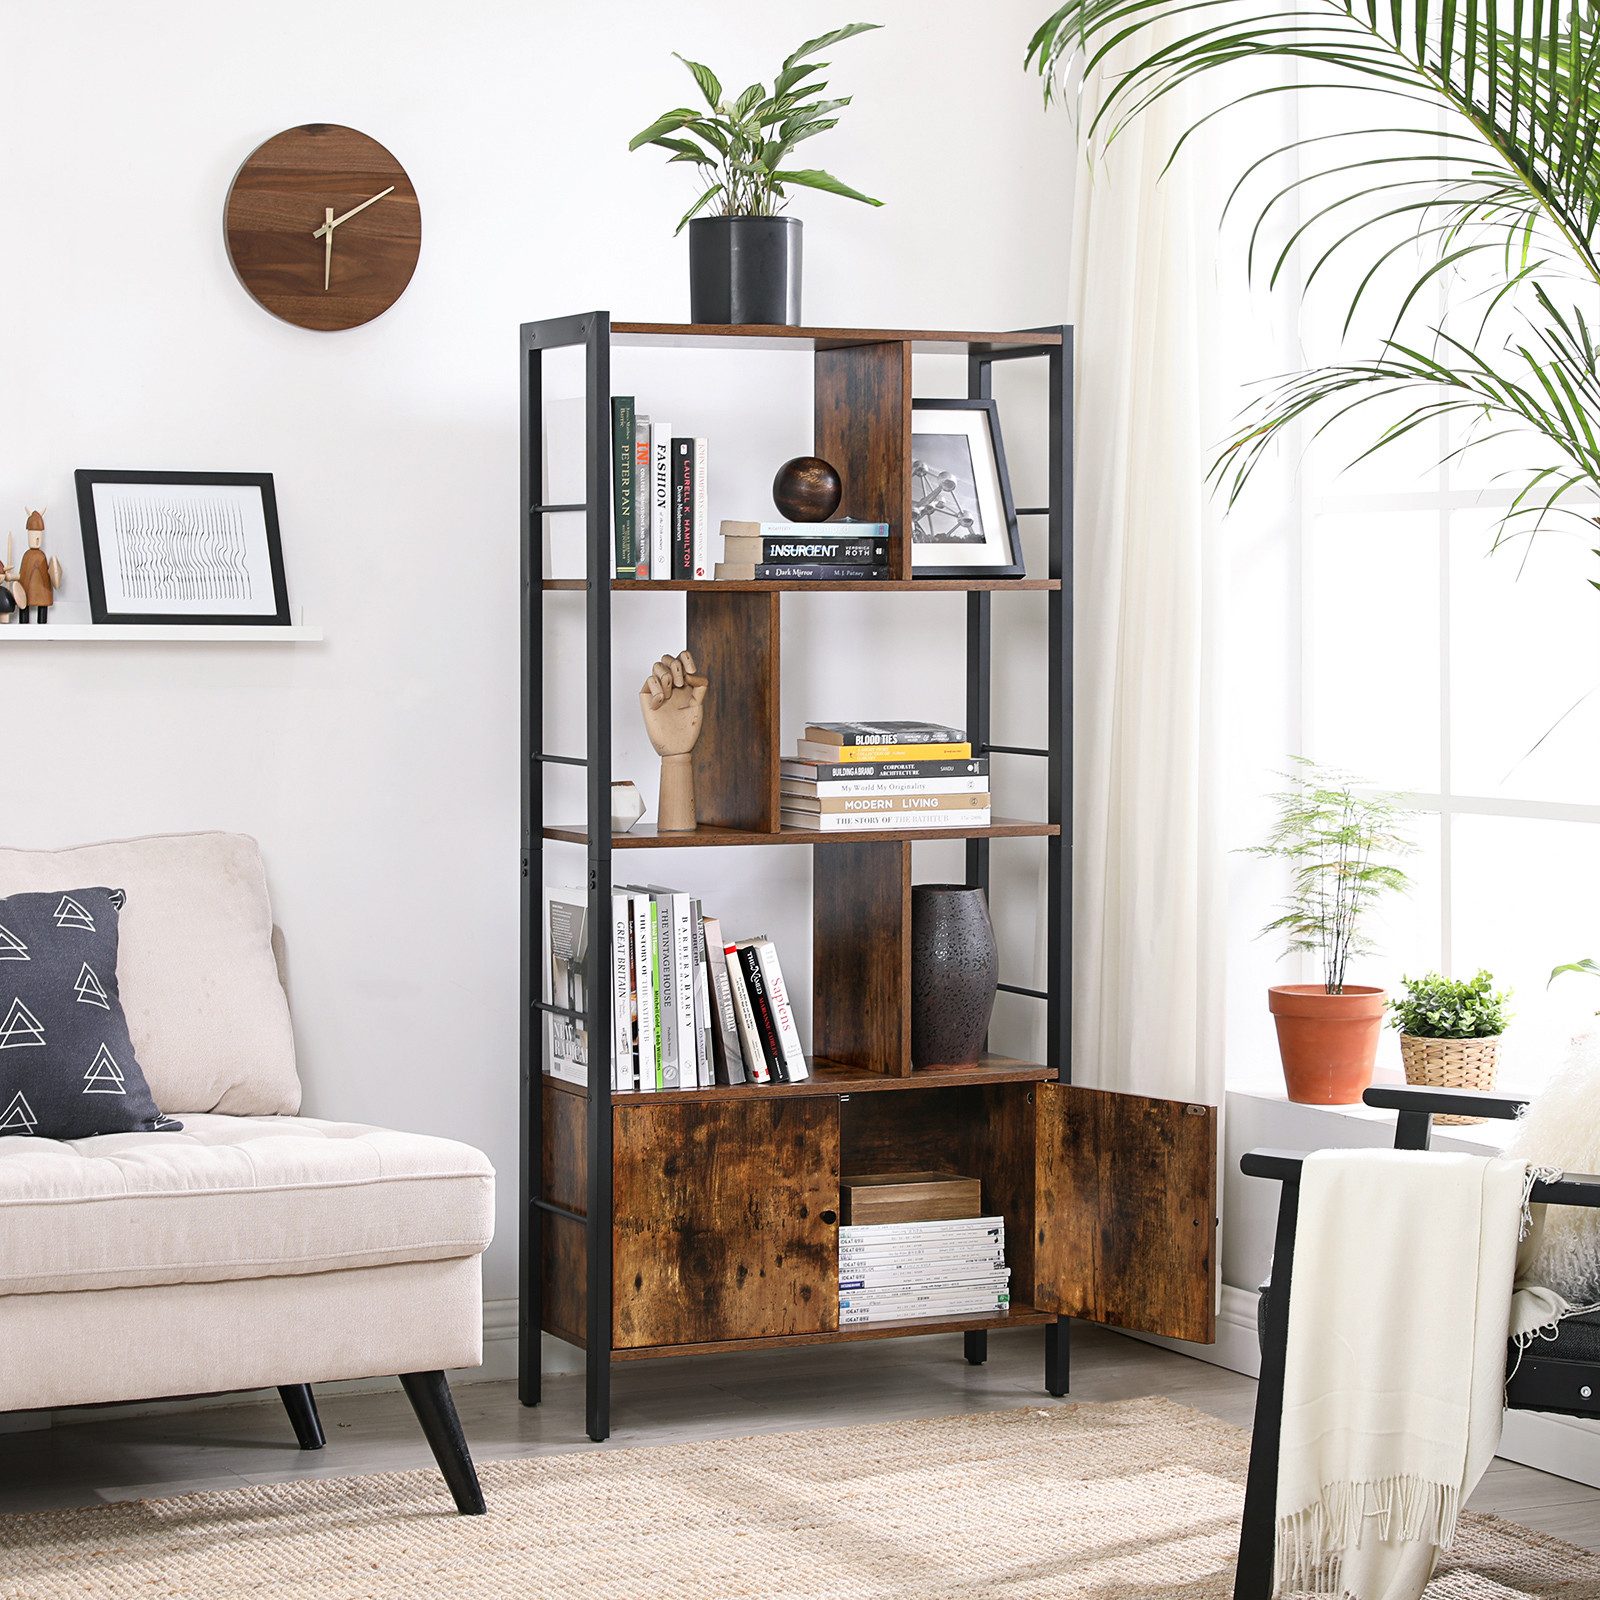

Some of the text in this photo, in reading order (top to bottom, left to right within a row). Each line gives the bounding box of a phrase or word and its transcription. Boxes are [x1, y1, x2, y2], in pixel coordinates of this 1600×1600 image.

[636, 442, 649, 465] IN!
[622, 445, 630, 516] PETER PAN
[657, 444, 666, 508] FASHION
[770, 544, 839, 557] INSURGENT
[775, 568, 813, 577] Dark Mirror
[856, 734, 880, 745] BLOOD
[881, 734, 898, 745] TIES
[841, 782, 926, 792] My World My Originality
[845, 797, 939, 810] MODERN LIVING
[836, 816, 853, 825] THE
[855, 816, 880, 824] STORY
[617, 922, 625, 955] GREAT
[662, 931, 670, 973] VINTAGE
[618, 957, 627, 998] BRITAIN
[664, 973, 672, 1007] HOUSE
[771, 977, 791, 1032] Sapiens
